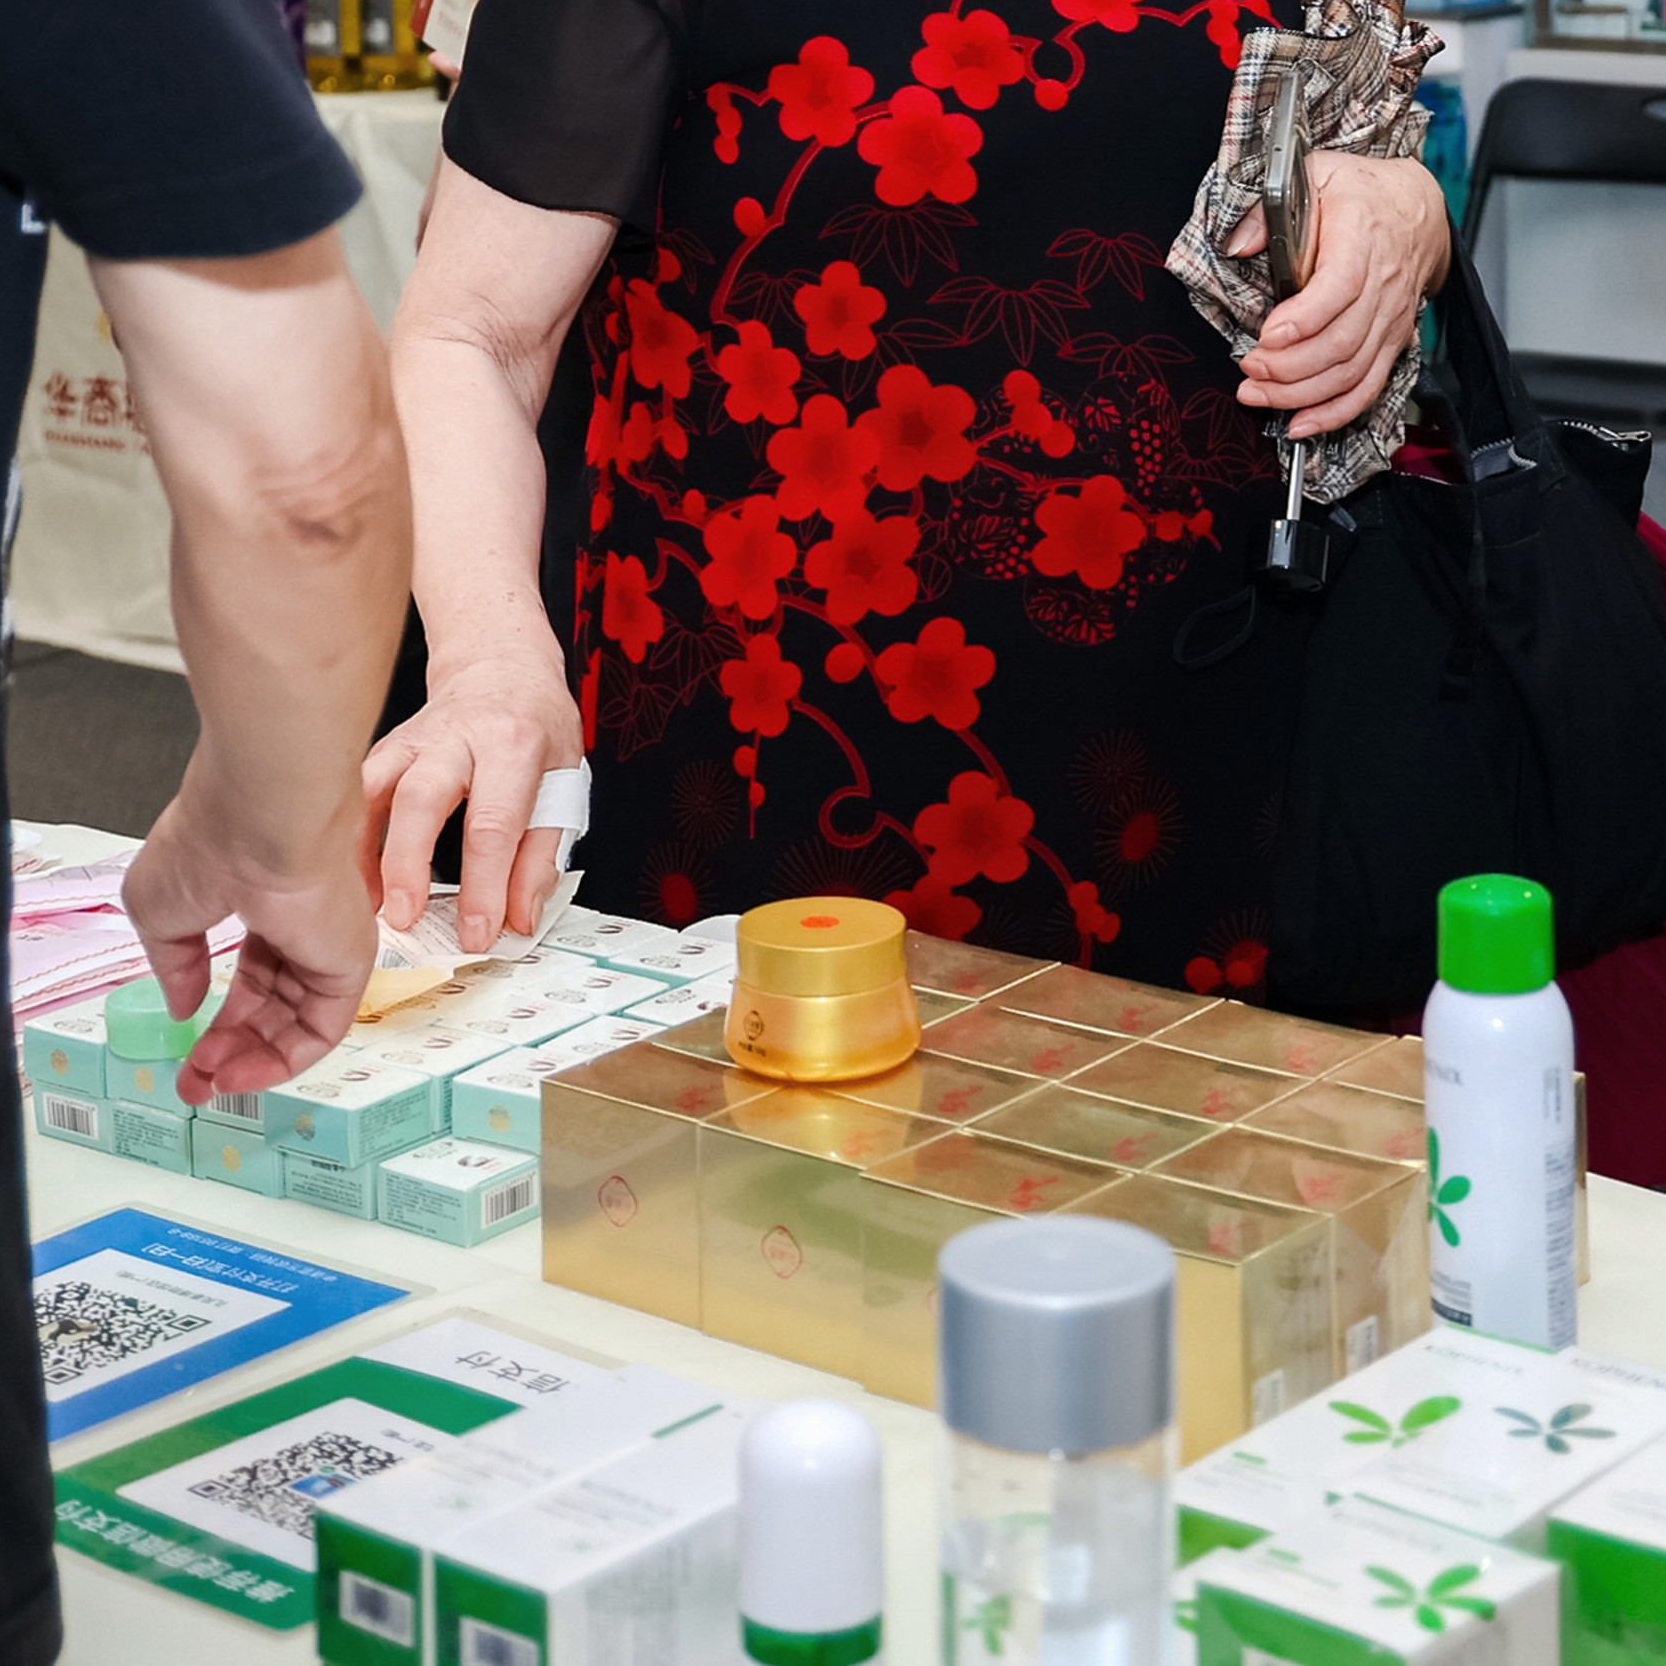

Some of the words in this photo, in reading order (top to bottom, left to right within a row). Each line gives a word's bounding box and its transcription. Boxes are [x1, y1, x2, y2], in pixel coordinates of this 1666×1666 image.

[43, 370, 134, 427] 华商
[454, 1350, 571, 1394] 信支付
[54, 1499, 295, 1604] 推荐使用微信支付
